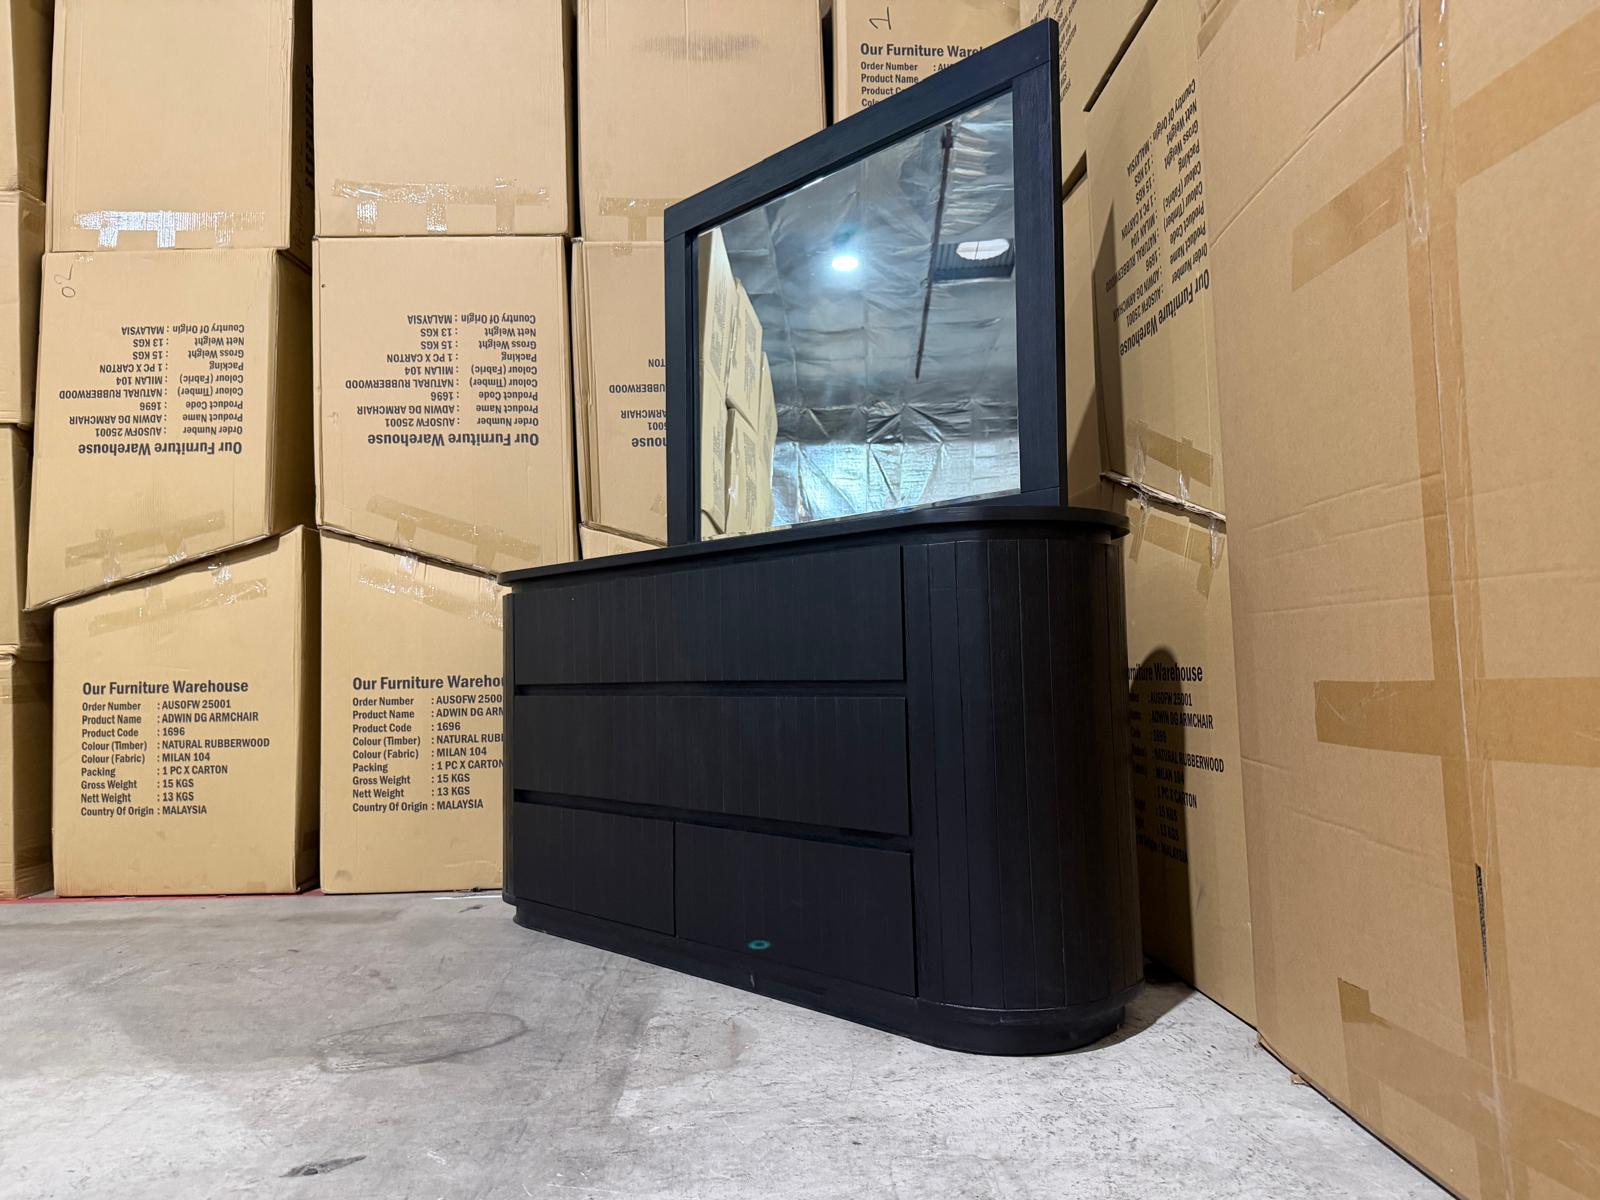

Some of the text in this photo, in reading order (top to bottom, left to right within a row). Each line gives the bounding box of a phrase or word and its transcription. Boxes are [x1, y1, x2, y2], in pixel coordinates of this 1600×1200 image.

[860, 43, 883, 55] Our
[886, 43, 944, 57] Furniture
[860, 61, 918, 71] Order Number
[861, 74, 919, 84] Product Name
[861, 86, 894, 95] Product
[1182, 119, 1199, 145] Gross
[1164, 139, 1183, 170] Weight
[1145, 176, 1152, 194] 15
[1183, 200, 1205, 233] Product
[1169, 223, 1184, 245] Code
[1192, 242, 1208, 265] Order
[1171, 257, 1192, 284] Number
[1119, 268, 1210, 356] Our Furniture Warehouse
[121, 322, 245, 336] Country Of Origin MALAYSIA
[132, 335, 245, 348] Nett Weight 13 KGS
[132, 347, 245, 361] Gross Weight 15 KGS
[99, 360, 244, 374] Packing 1 PC X CARTON
[115, 373, 244, 386] Colour (Fabric) MILAN 104
[345, 376, 538, 389] Colour (Timber) NATURAL RUBBERWOOD
[58, 385, 244, 400] Colour (Timber) NATURAL RUBBERWOOD
[609, 384, 666, 393] UBBERWOOD
[430, 391, 538, 402] Product Code 1696
[139, 400, 244, 411] Product Code 1696
[356, 404, 539, 415] Product Name ADWIN DG ARMCHAIR
[69, 413, 243, 425] Product Name ADWIN DG ARMCHAIR
[384, 417, 539, 428] Order Number AUSOFW 25001
[95, 425, 243, 438] Order Number AUSOFW 25001
[367, 433, 540, 447] Our Furniture Warehouse
[78, 441, 243, 457] Our Furniture Warehouse
[1153, 662, 1203, 682] Warehouse
[82, 679, 249, 696] Our Furniture Warehouse
[352, 674, 503, 691] Our Furniture Wareho
[81, 699, 232, 712] Order Number AUSOFW 25001
[352, 693, 502, 707] Order Number AUSOFW 2500
[81, 711, 259, 725] Product Name ADWIN DG ARMCHAIR
[1179, 712, 1214, 729] ARMCHAIR
[81, 726, 186, 738] Product Code 1696
[81, 737, 270, 753] Colour (Timber) NATURAL RUBBERWOOD
[81, 752, 211, 765] Colour (Fabric) MILAN 104
[352, 746, 487, 761] Colour (Fabric) MILAN 104
[1179, 752, 1225, 773] RUBBERWOOD
[81, 764, 228, 779] Packing 1 PC X CARTON
[80, 778, 194, 791] Gross Weight 15 KGS
[80, 791, 195, 805] Nett Weight 13 KGS
[80, 804, 207, 818] Country Of Origin MALAYSIA
[352, 798, 484, 814] Country Of Origin MALAYSIA
